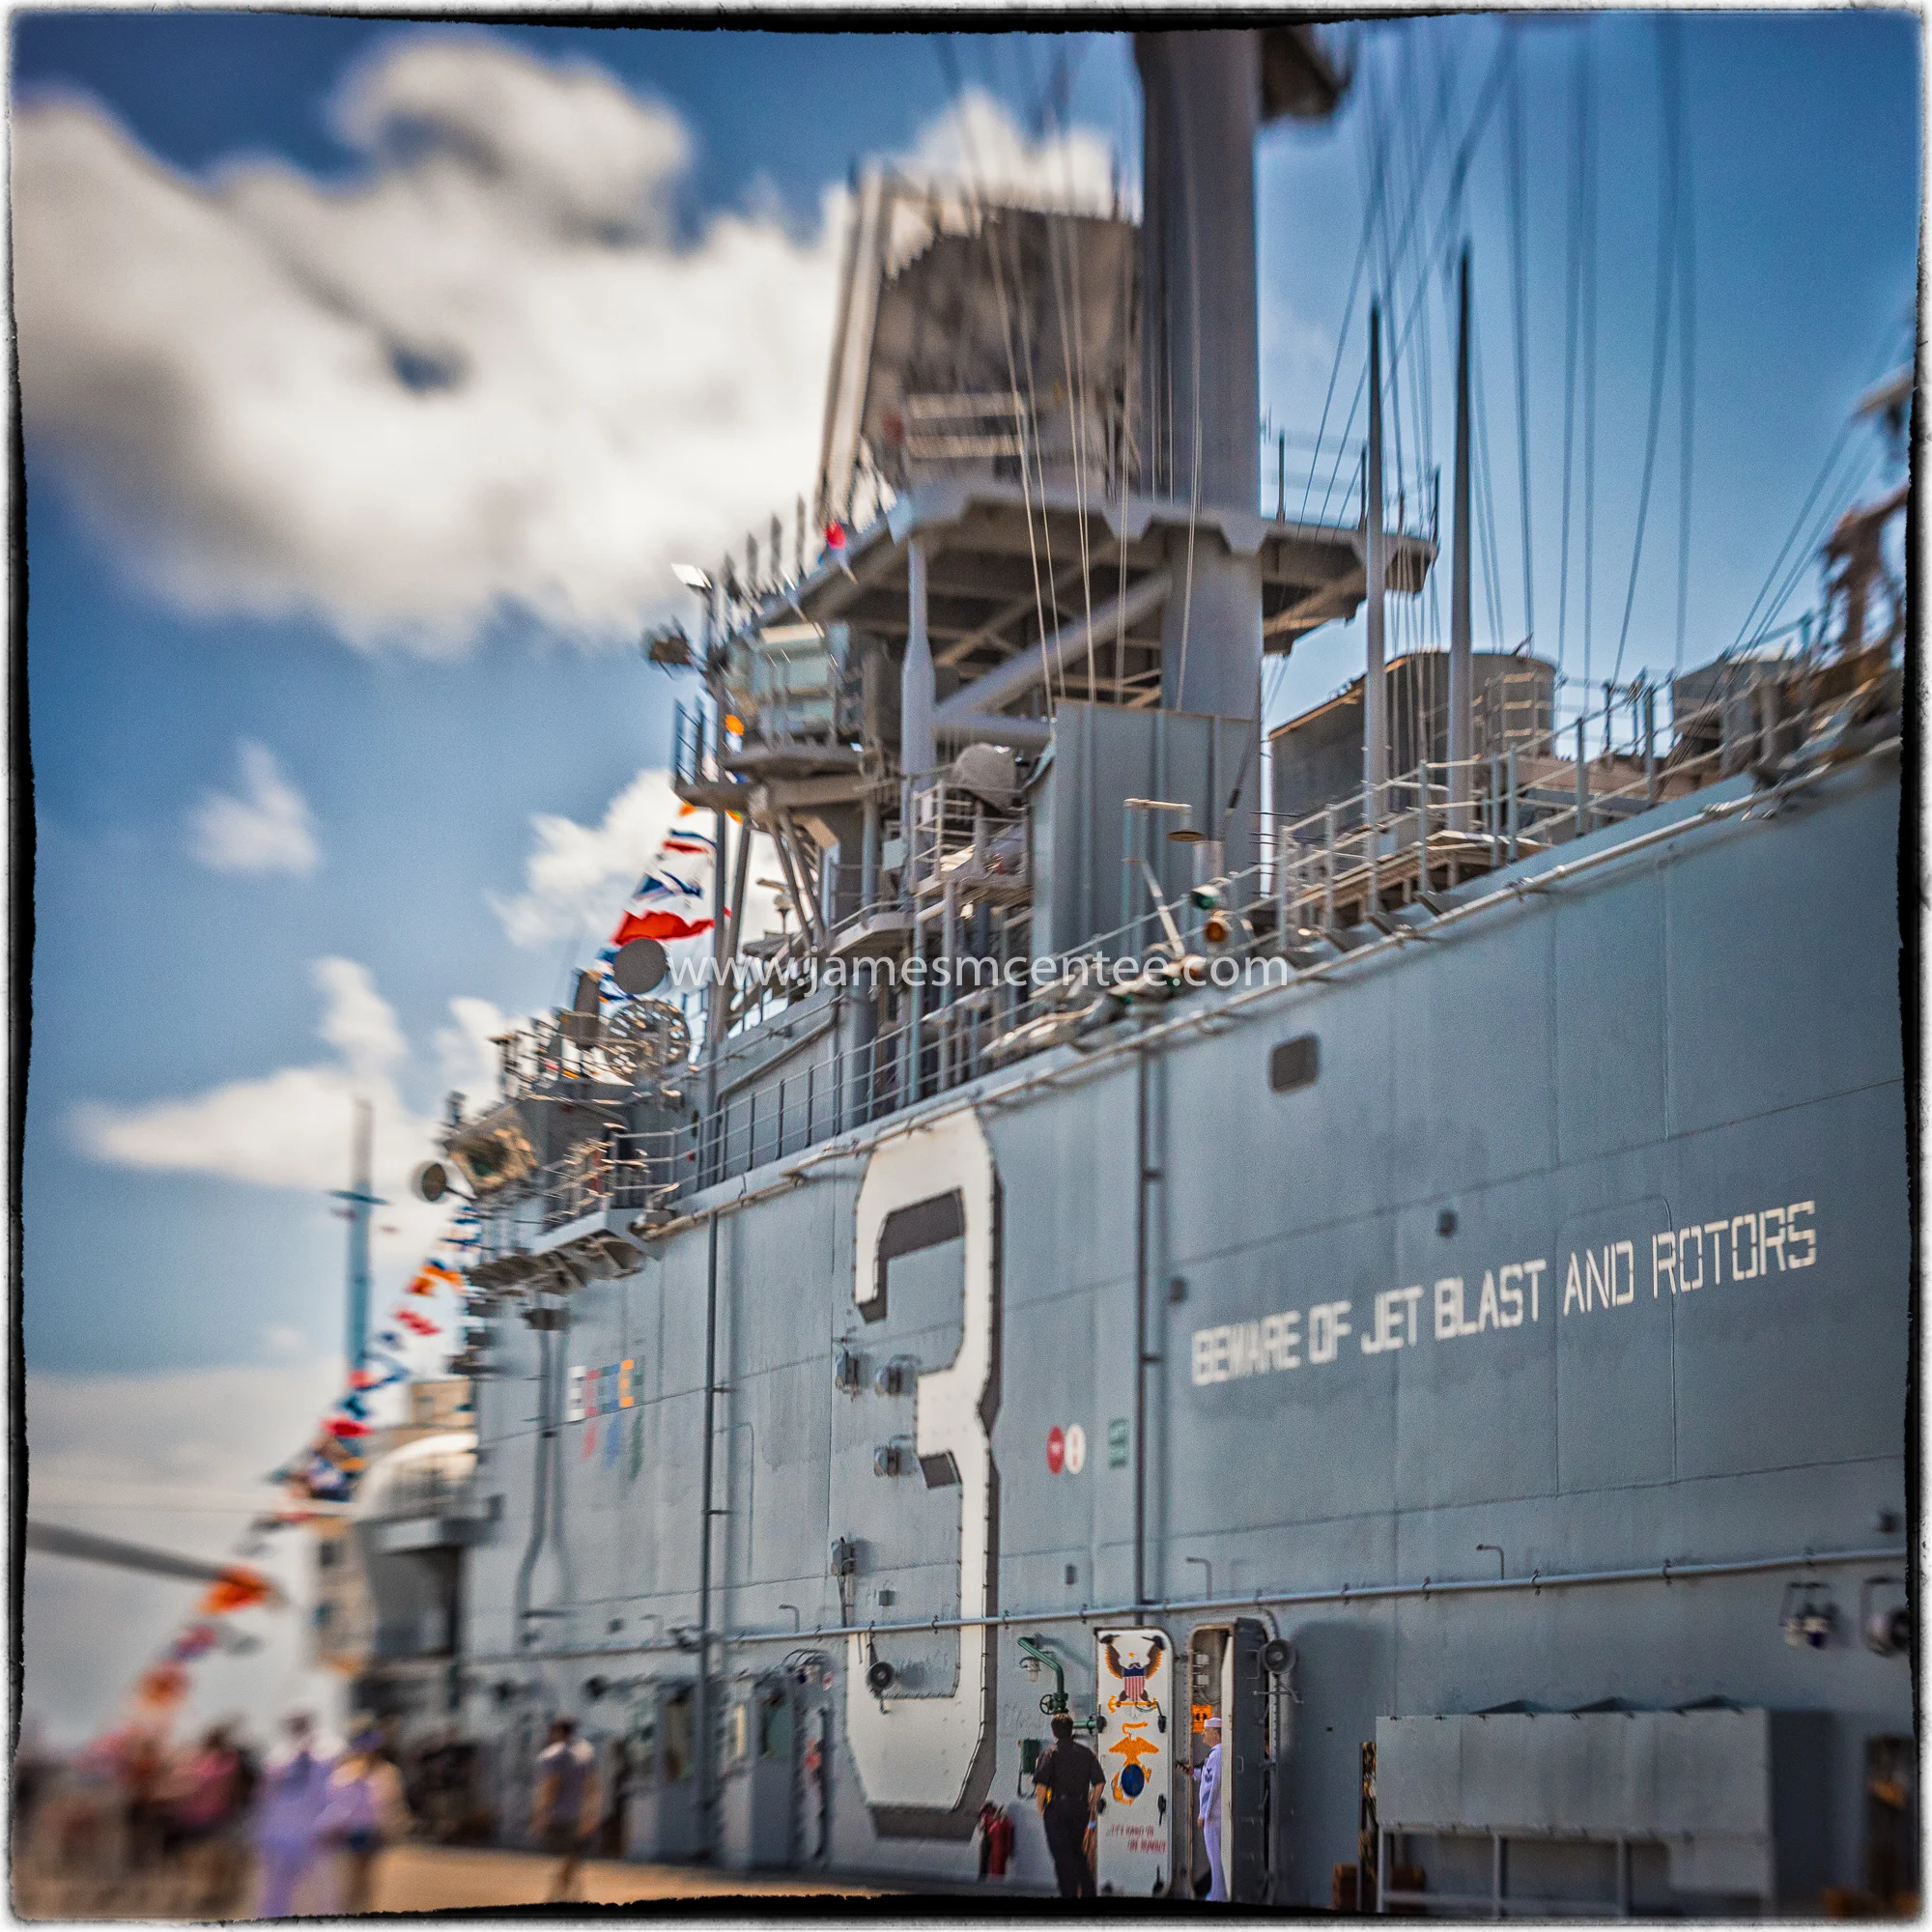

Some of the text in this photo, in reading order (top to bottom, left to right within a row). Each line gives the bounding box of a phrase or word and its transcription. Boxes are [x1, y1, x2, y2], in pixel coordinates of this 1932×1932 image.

[846, 1108, 1001, 1838] 3
[1192, 1201, 1816, 1385] BEWARE OF JET BLAST AND ROTORS
